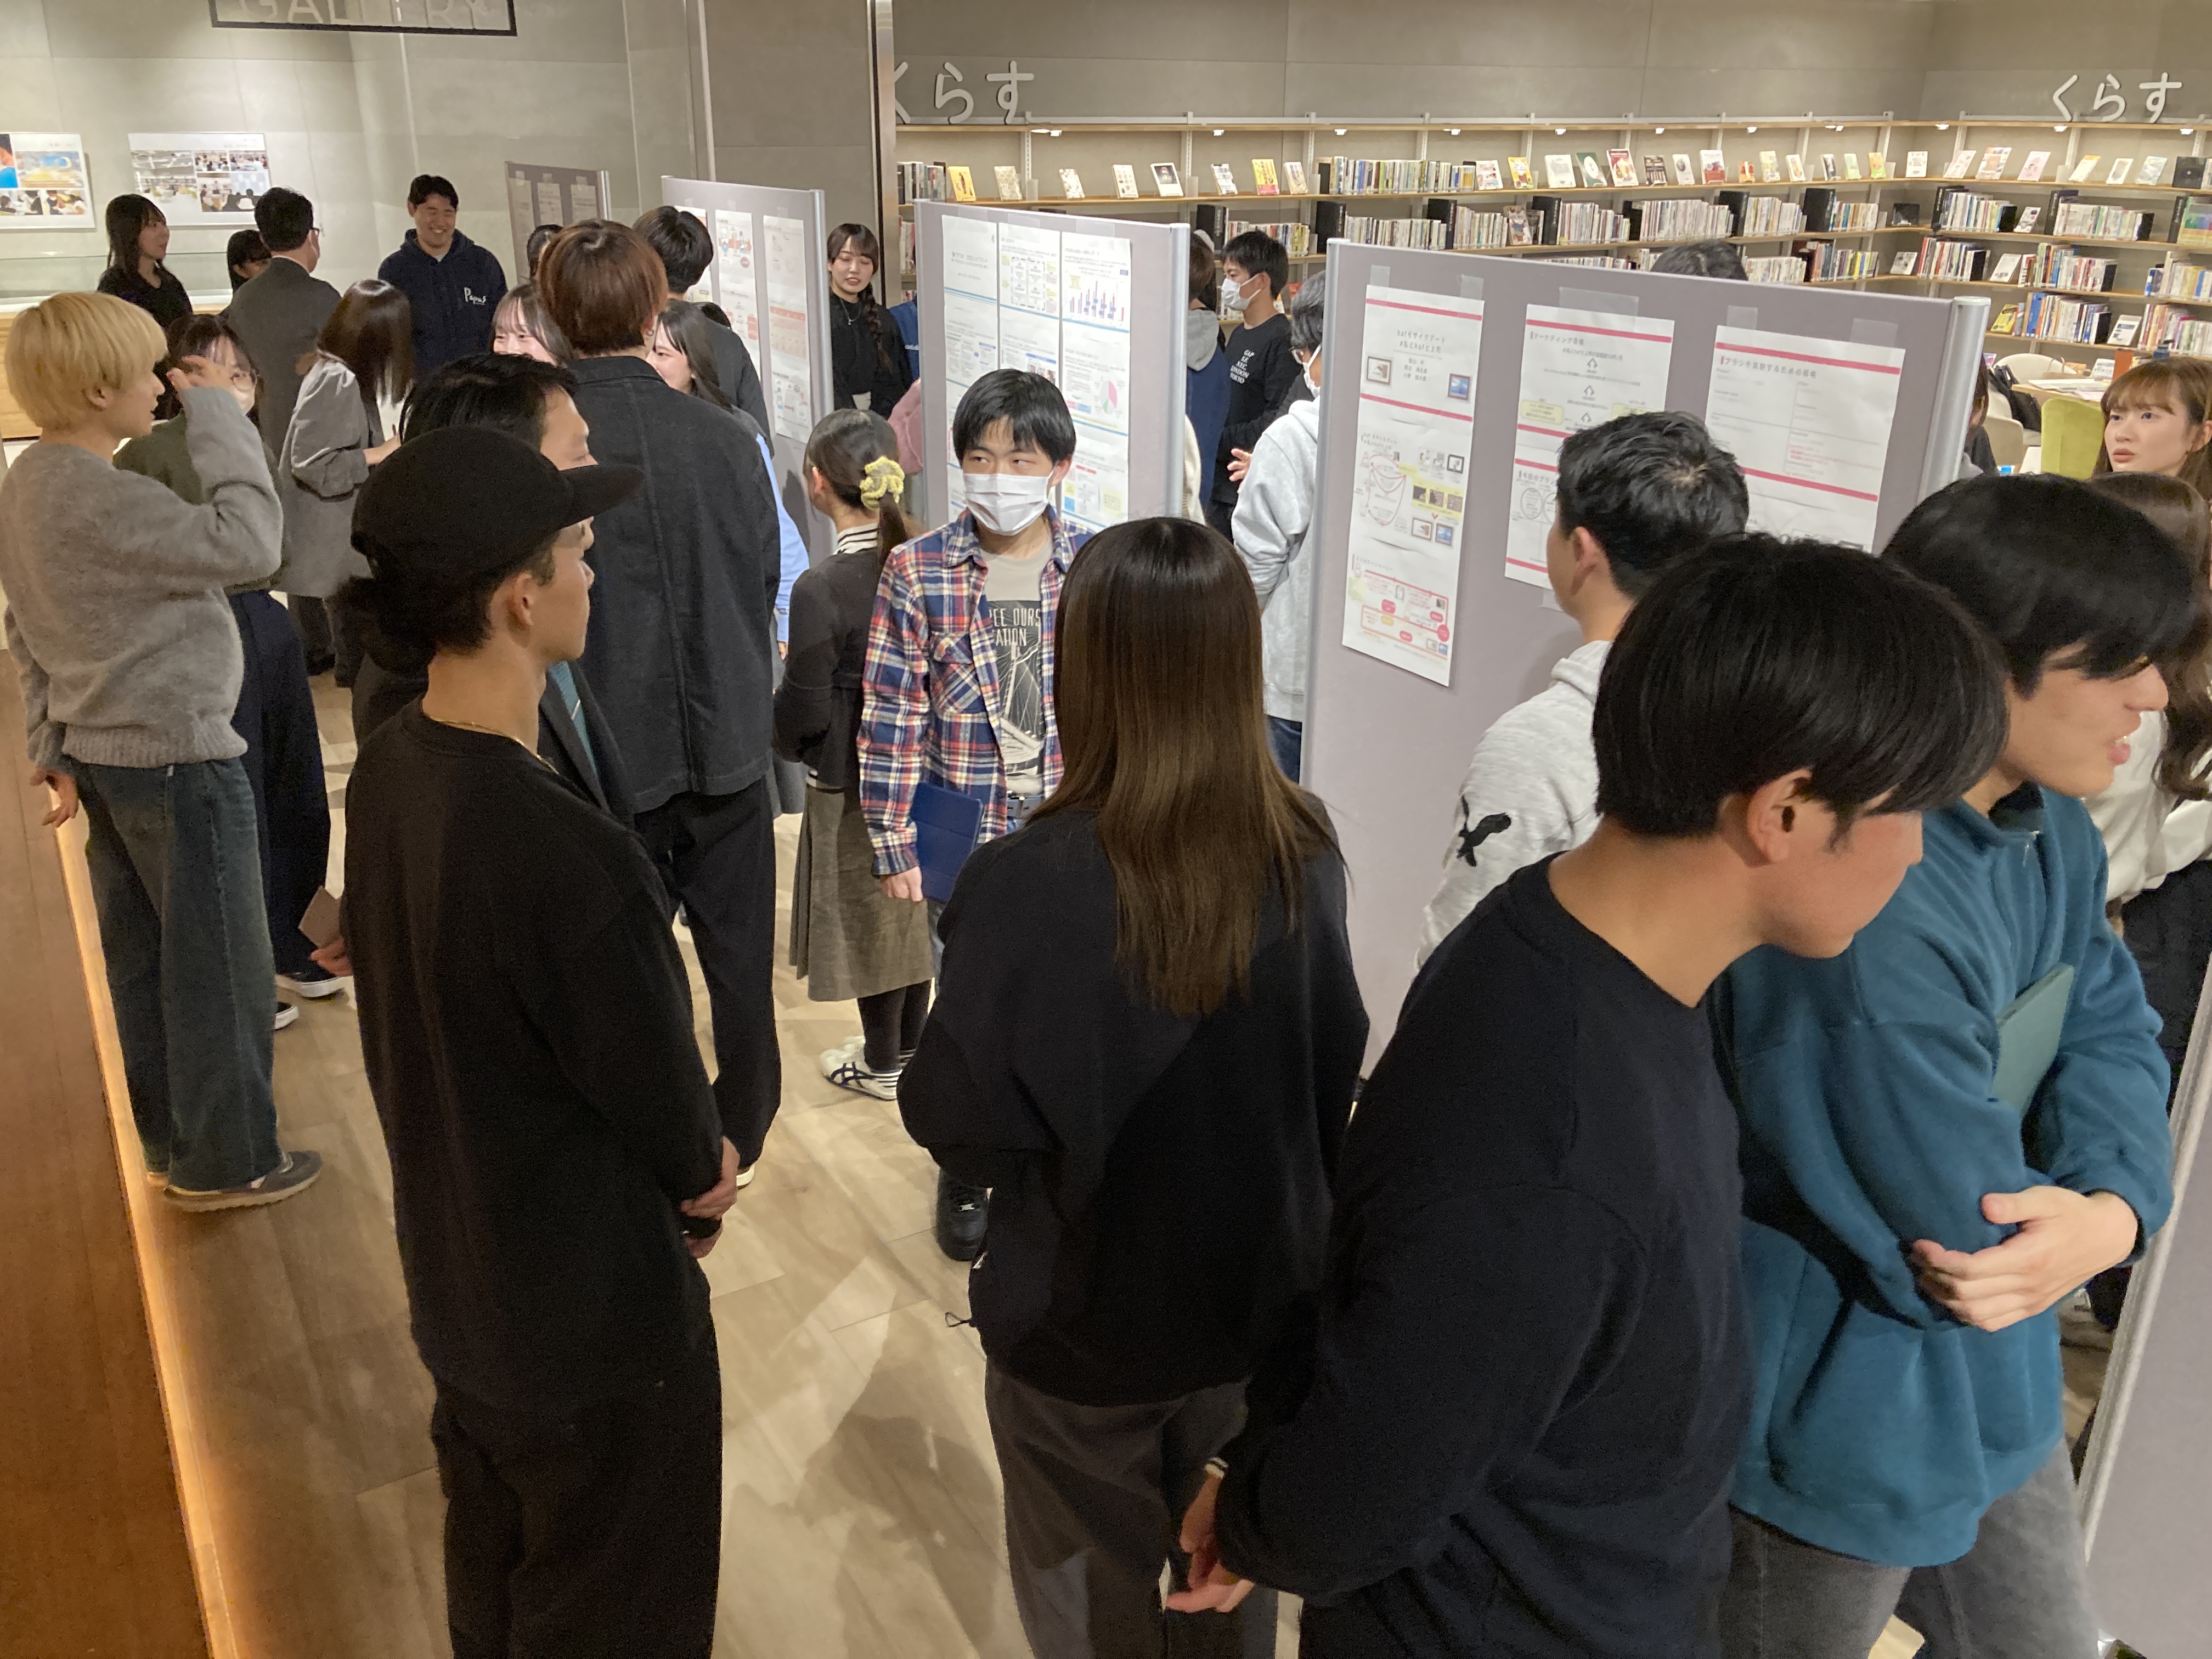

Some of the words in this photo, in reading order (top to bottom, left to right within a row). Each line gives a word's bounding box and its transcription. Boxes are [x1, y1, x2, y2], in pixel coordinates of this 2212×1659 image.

[2053, 72, 2182, 123] くらす
[1244, 349, 1255, 358] GAP
[1230, 365, 1249, 379] LONDON
[1230, 372, 1245, 384] TOKYO
[989, 608, 1007, 627] EE
[992, 628, 1027, 647] ATION
